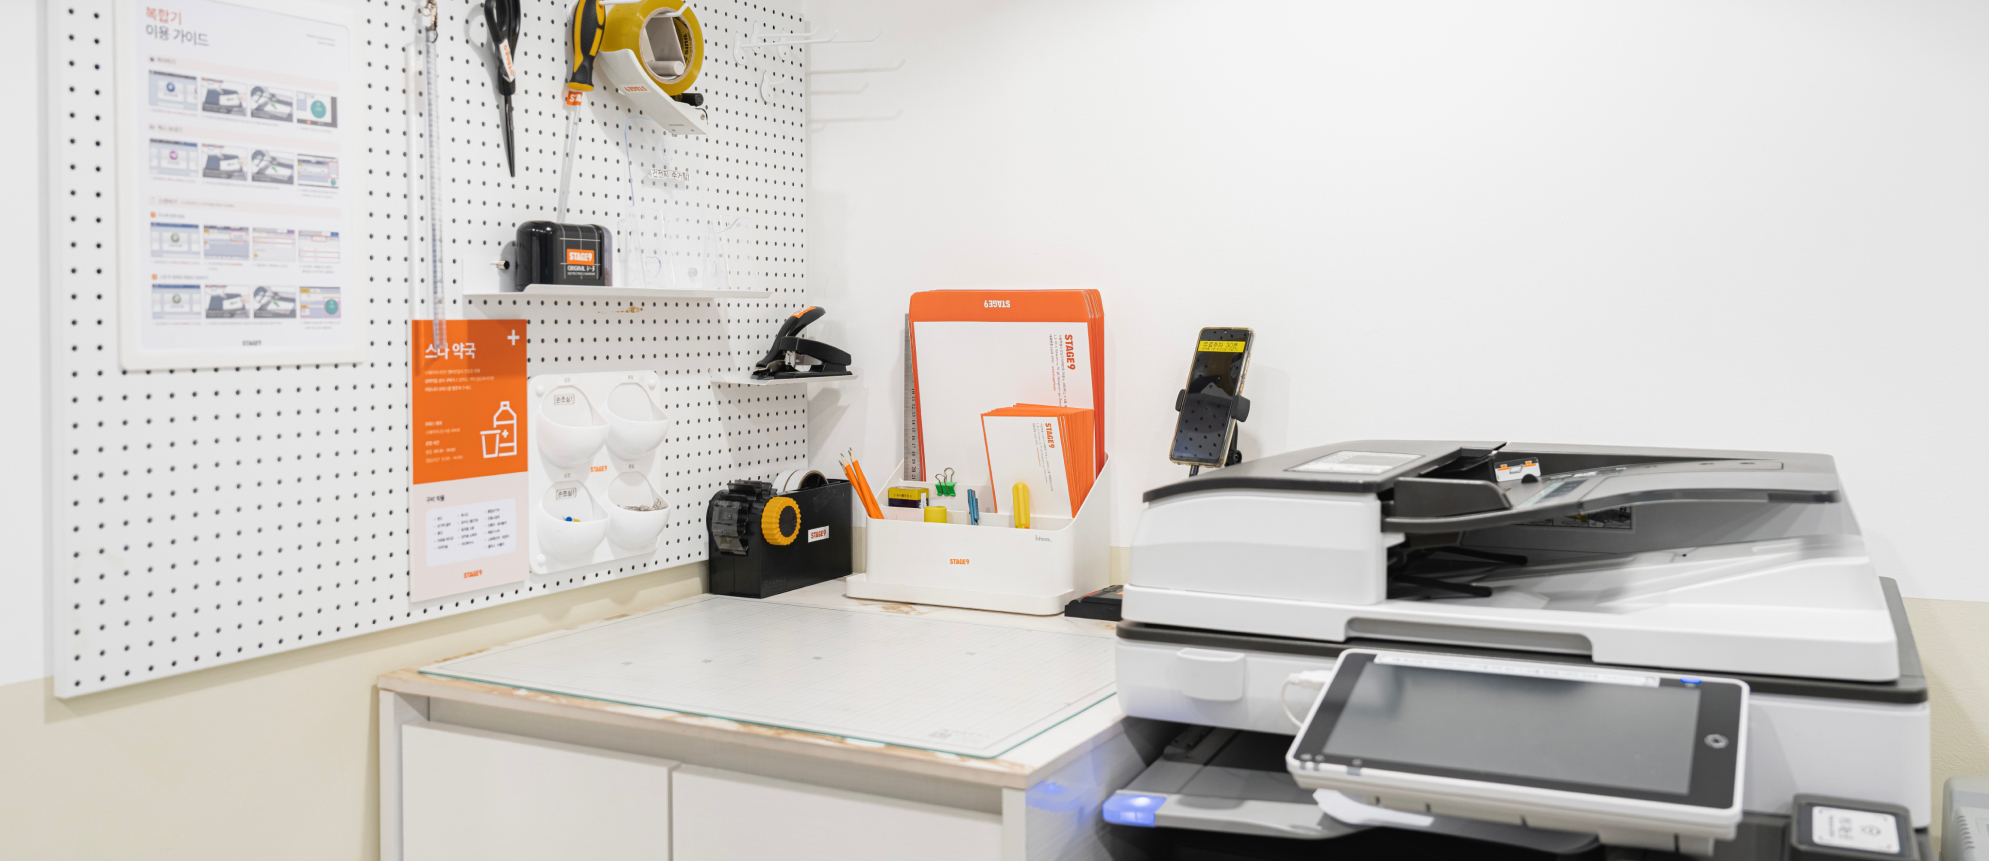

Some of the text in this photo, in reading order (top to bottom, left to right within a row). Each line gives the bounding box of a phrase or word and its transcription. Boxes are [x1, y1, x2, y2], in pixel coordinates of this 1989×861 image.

[145, 6, 182, 26] 복합기
[145, 24, 210, 46] 이용 가이드
[568, 251, 593, 262] STAGE9
[983, 299, 1011, 308] STAGE9
[452, 342, 477, 359] 약국
[1064, 333, 1076, 370] STAGE9
[1045, 423, 1055, 449] STAGE9
[590, 465, 608, 473] STAGE9
[810, 529, 827, 539] STAGE9
[463, 569, 483, 579] STAGE9
